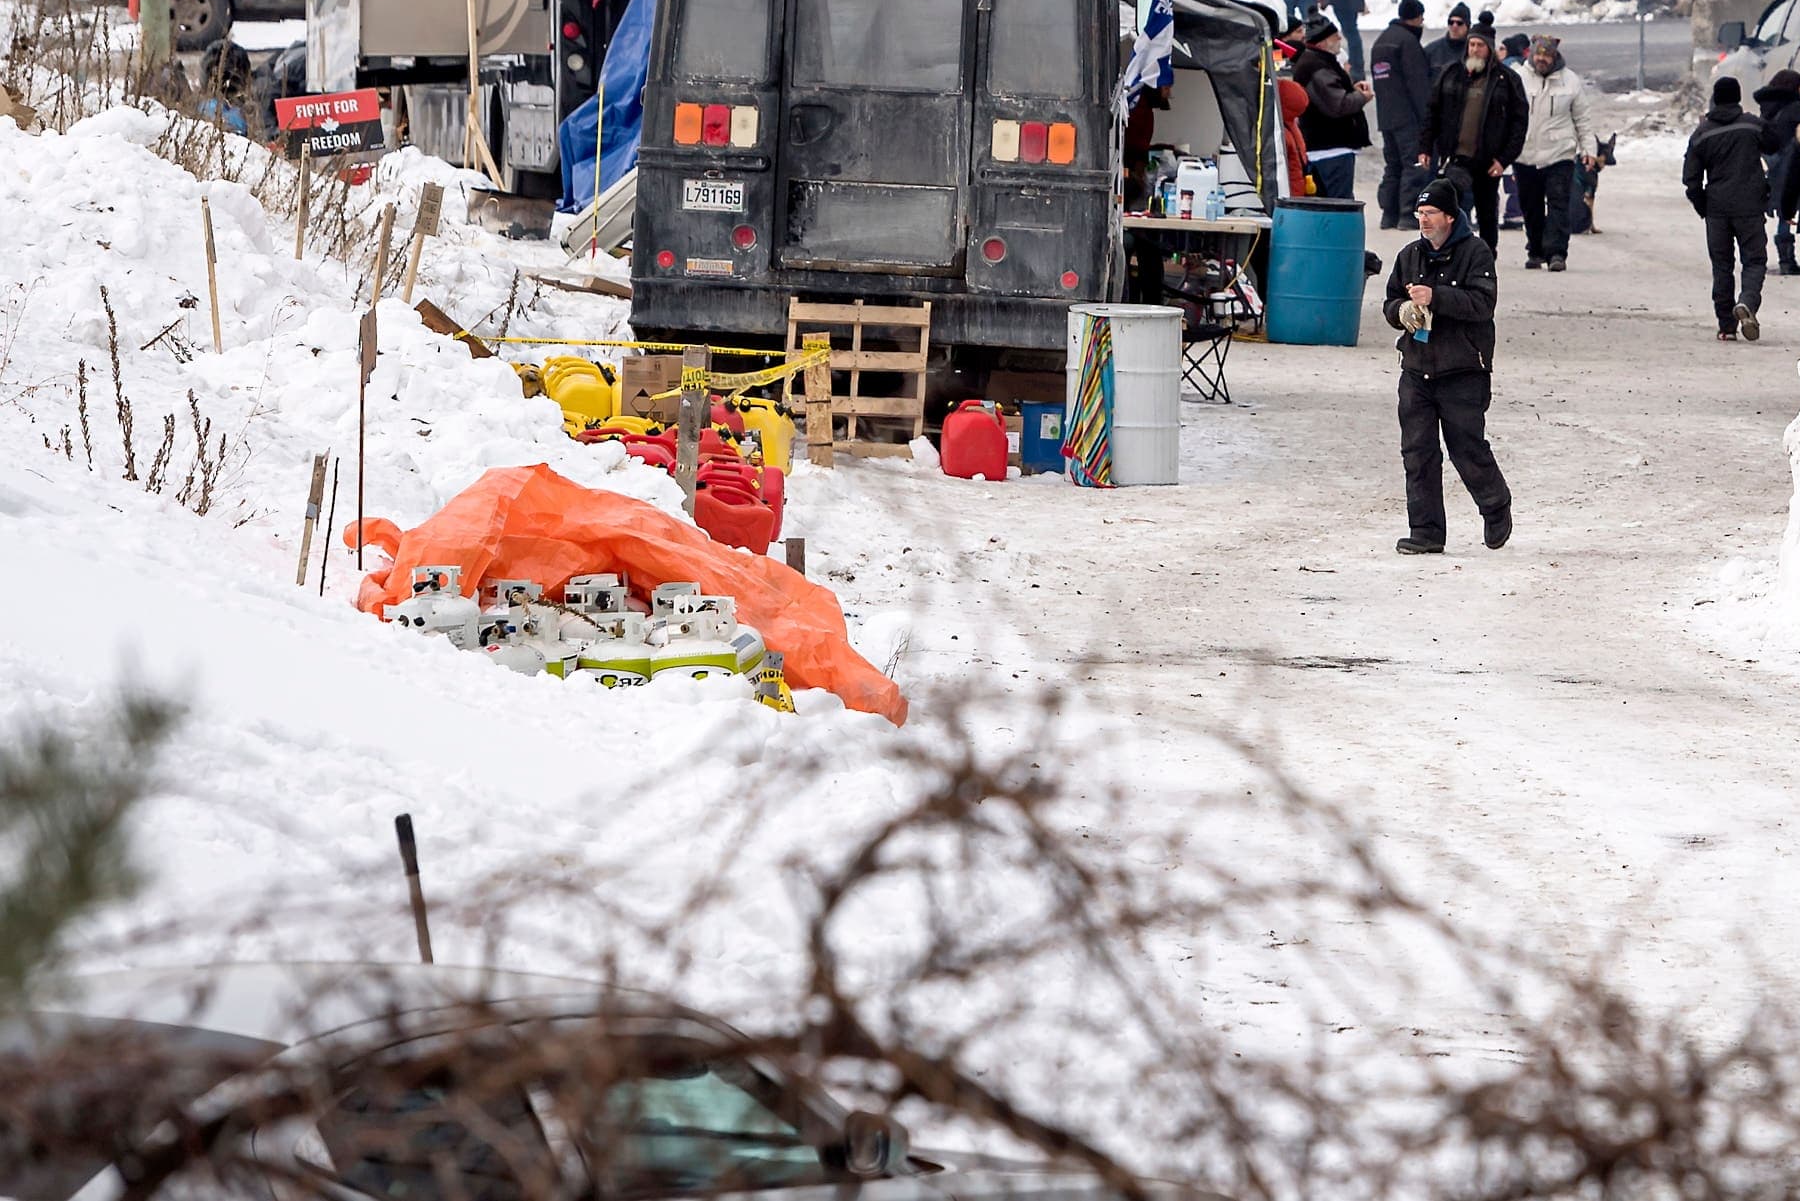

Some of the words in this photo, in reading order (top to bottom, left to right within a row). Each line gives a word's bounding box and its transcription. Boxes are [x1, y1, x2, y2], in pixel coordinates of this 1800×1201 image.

[295, 102, 331, 118] FIGHT
[334, 99, 359, 114] FOR
[305, 132, 361, 151] REEDOM
